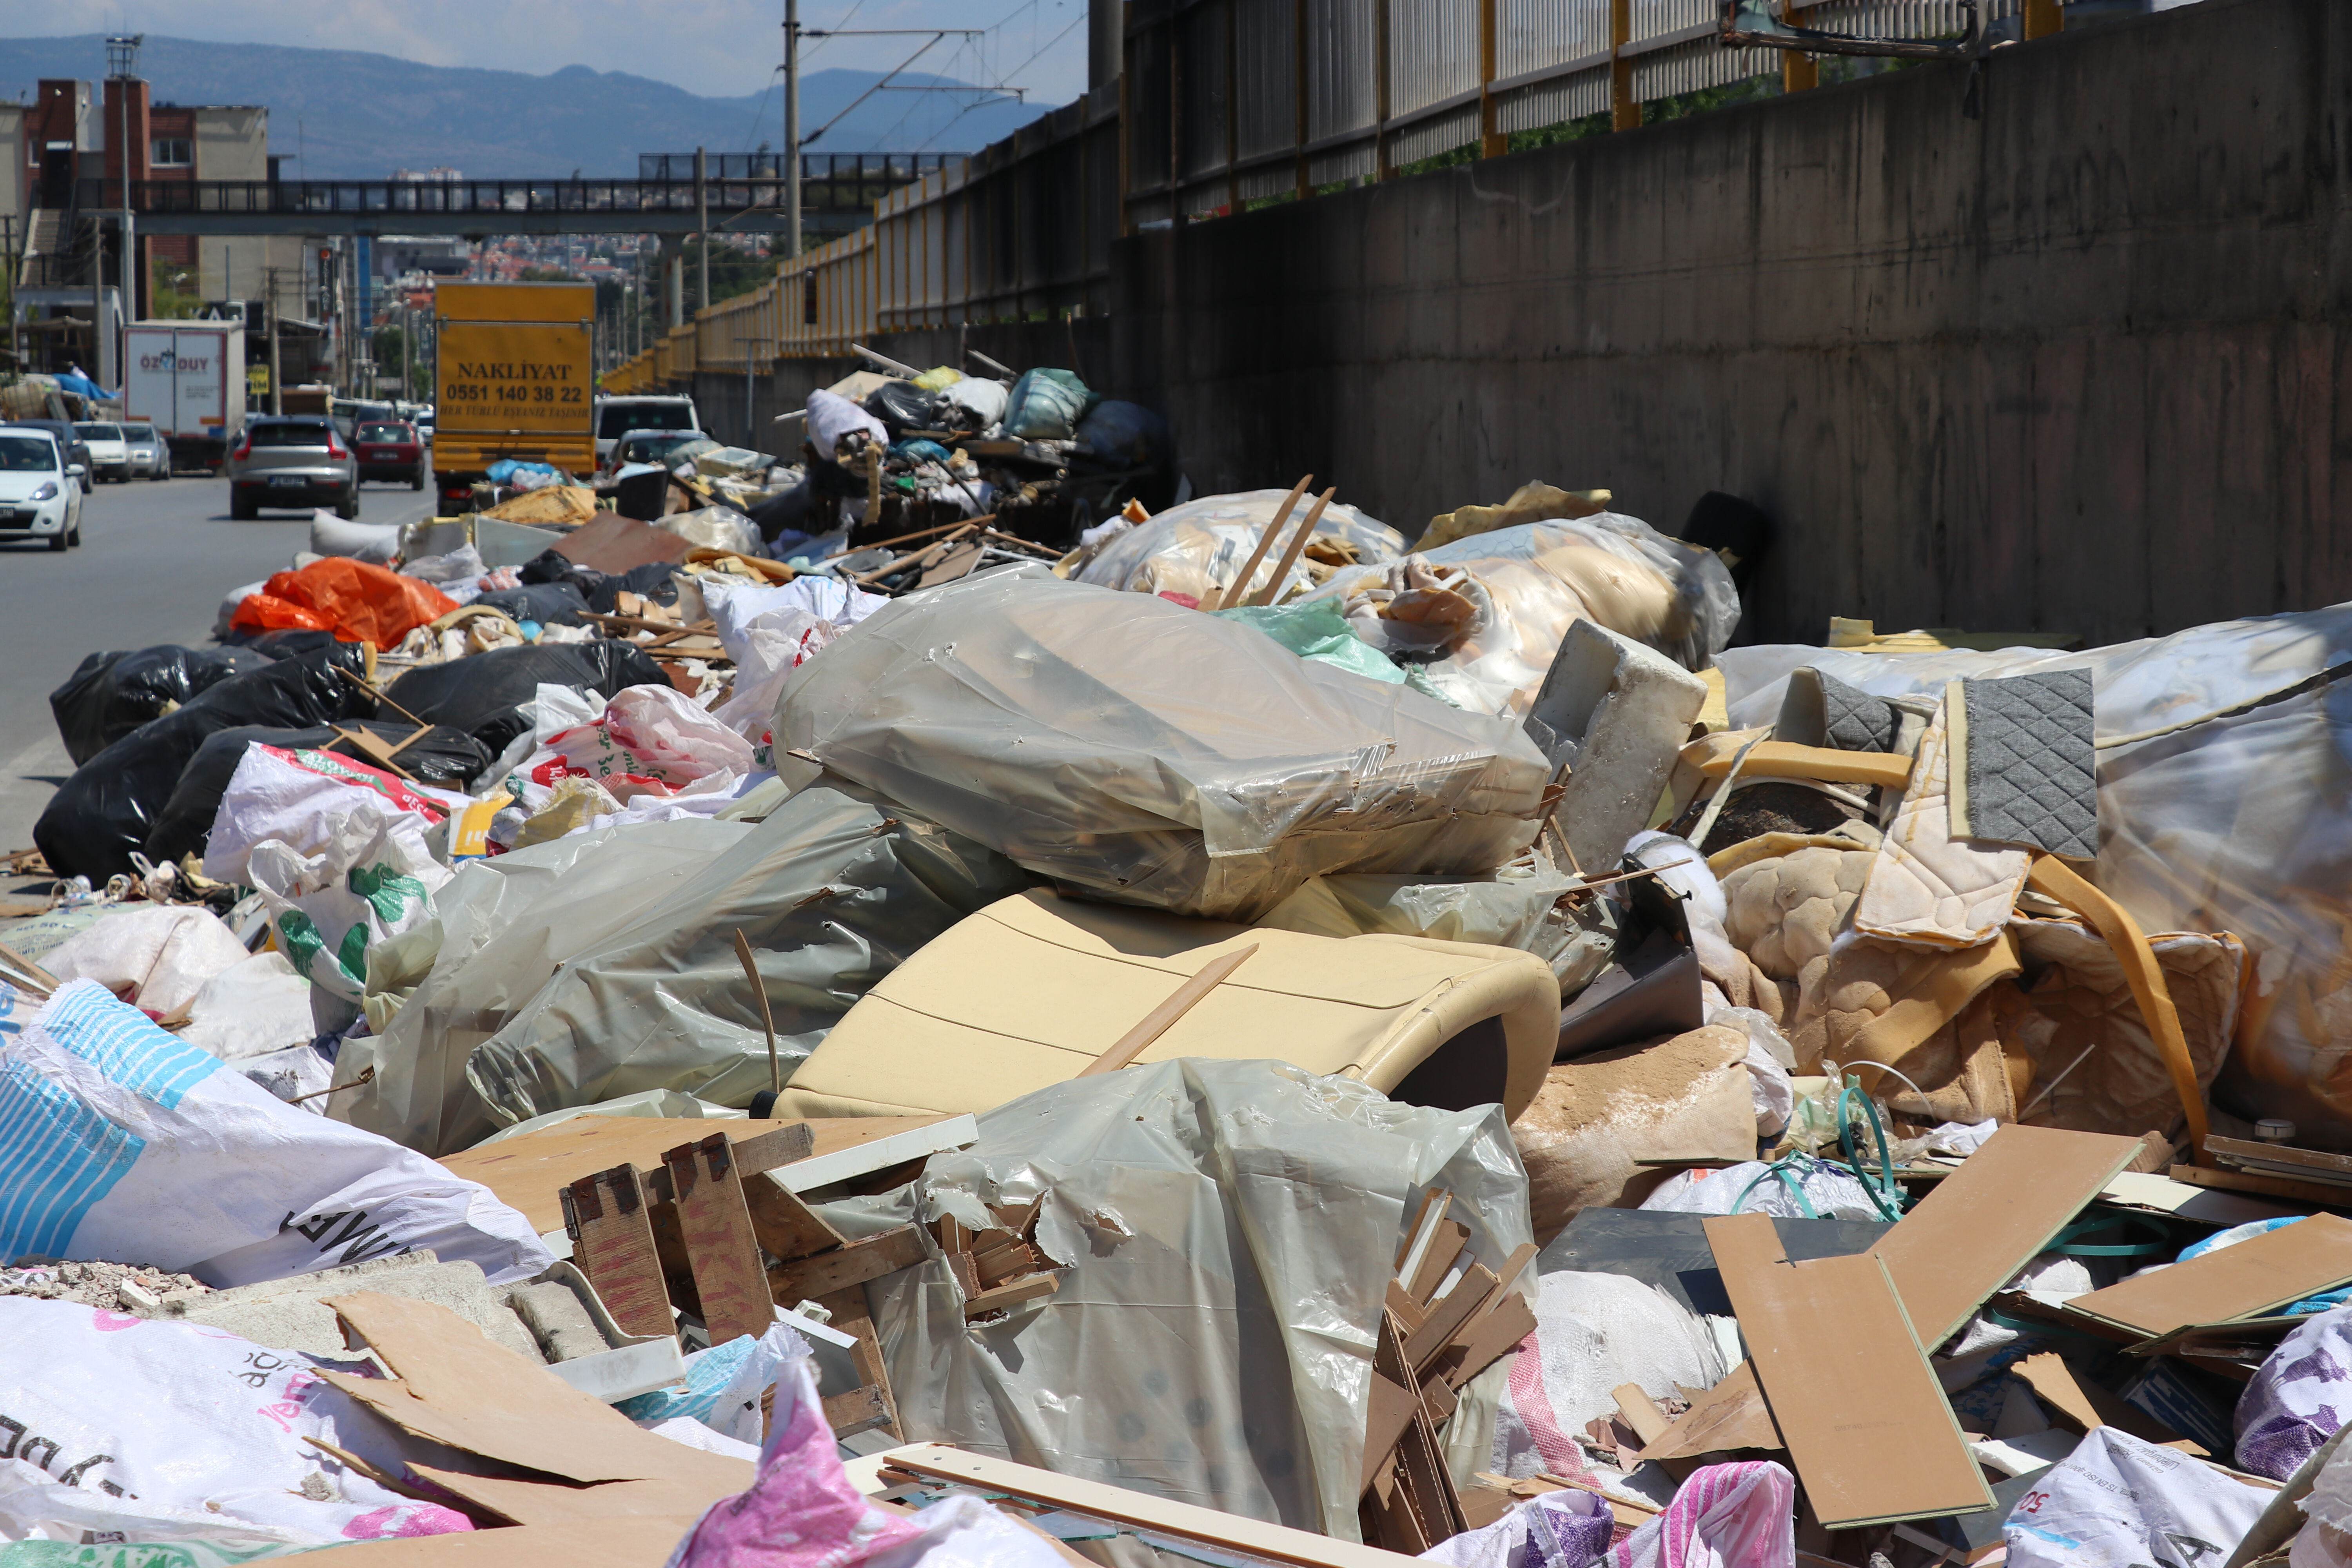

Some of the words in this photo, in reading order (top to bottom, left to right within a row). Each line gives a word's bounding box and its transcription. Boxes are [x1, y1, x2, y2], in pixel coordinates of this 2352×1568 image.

[140, 352, 160, 368] ÖZ
[177, 356, 208, 370] DUY
[457, 359, 572, 380] NAKLİYAT
[447, 384, 487, 400] 0551
[496, 385, 527, 401] 140
[534, 386, 554, 401] 38
[561, 387, 581, 402] 22
[440, 405, 462, 416] HER
